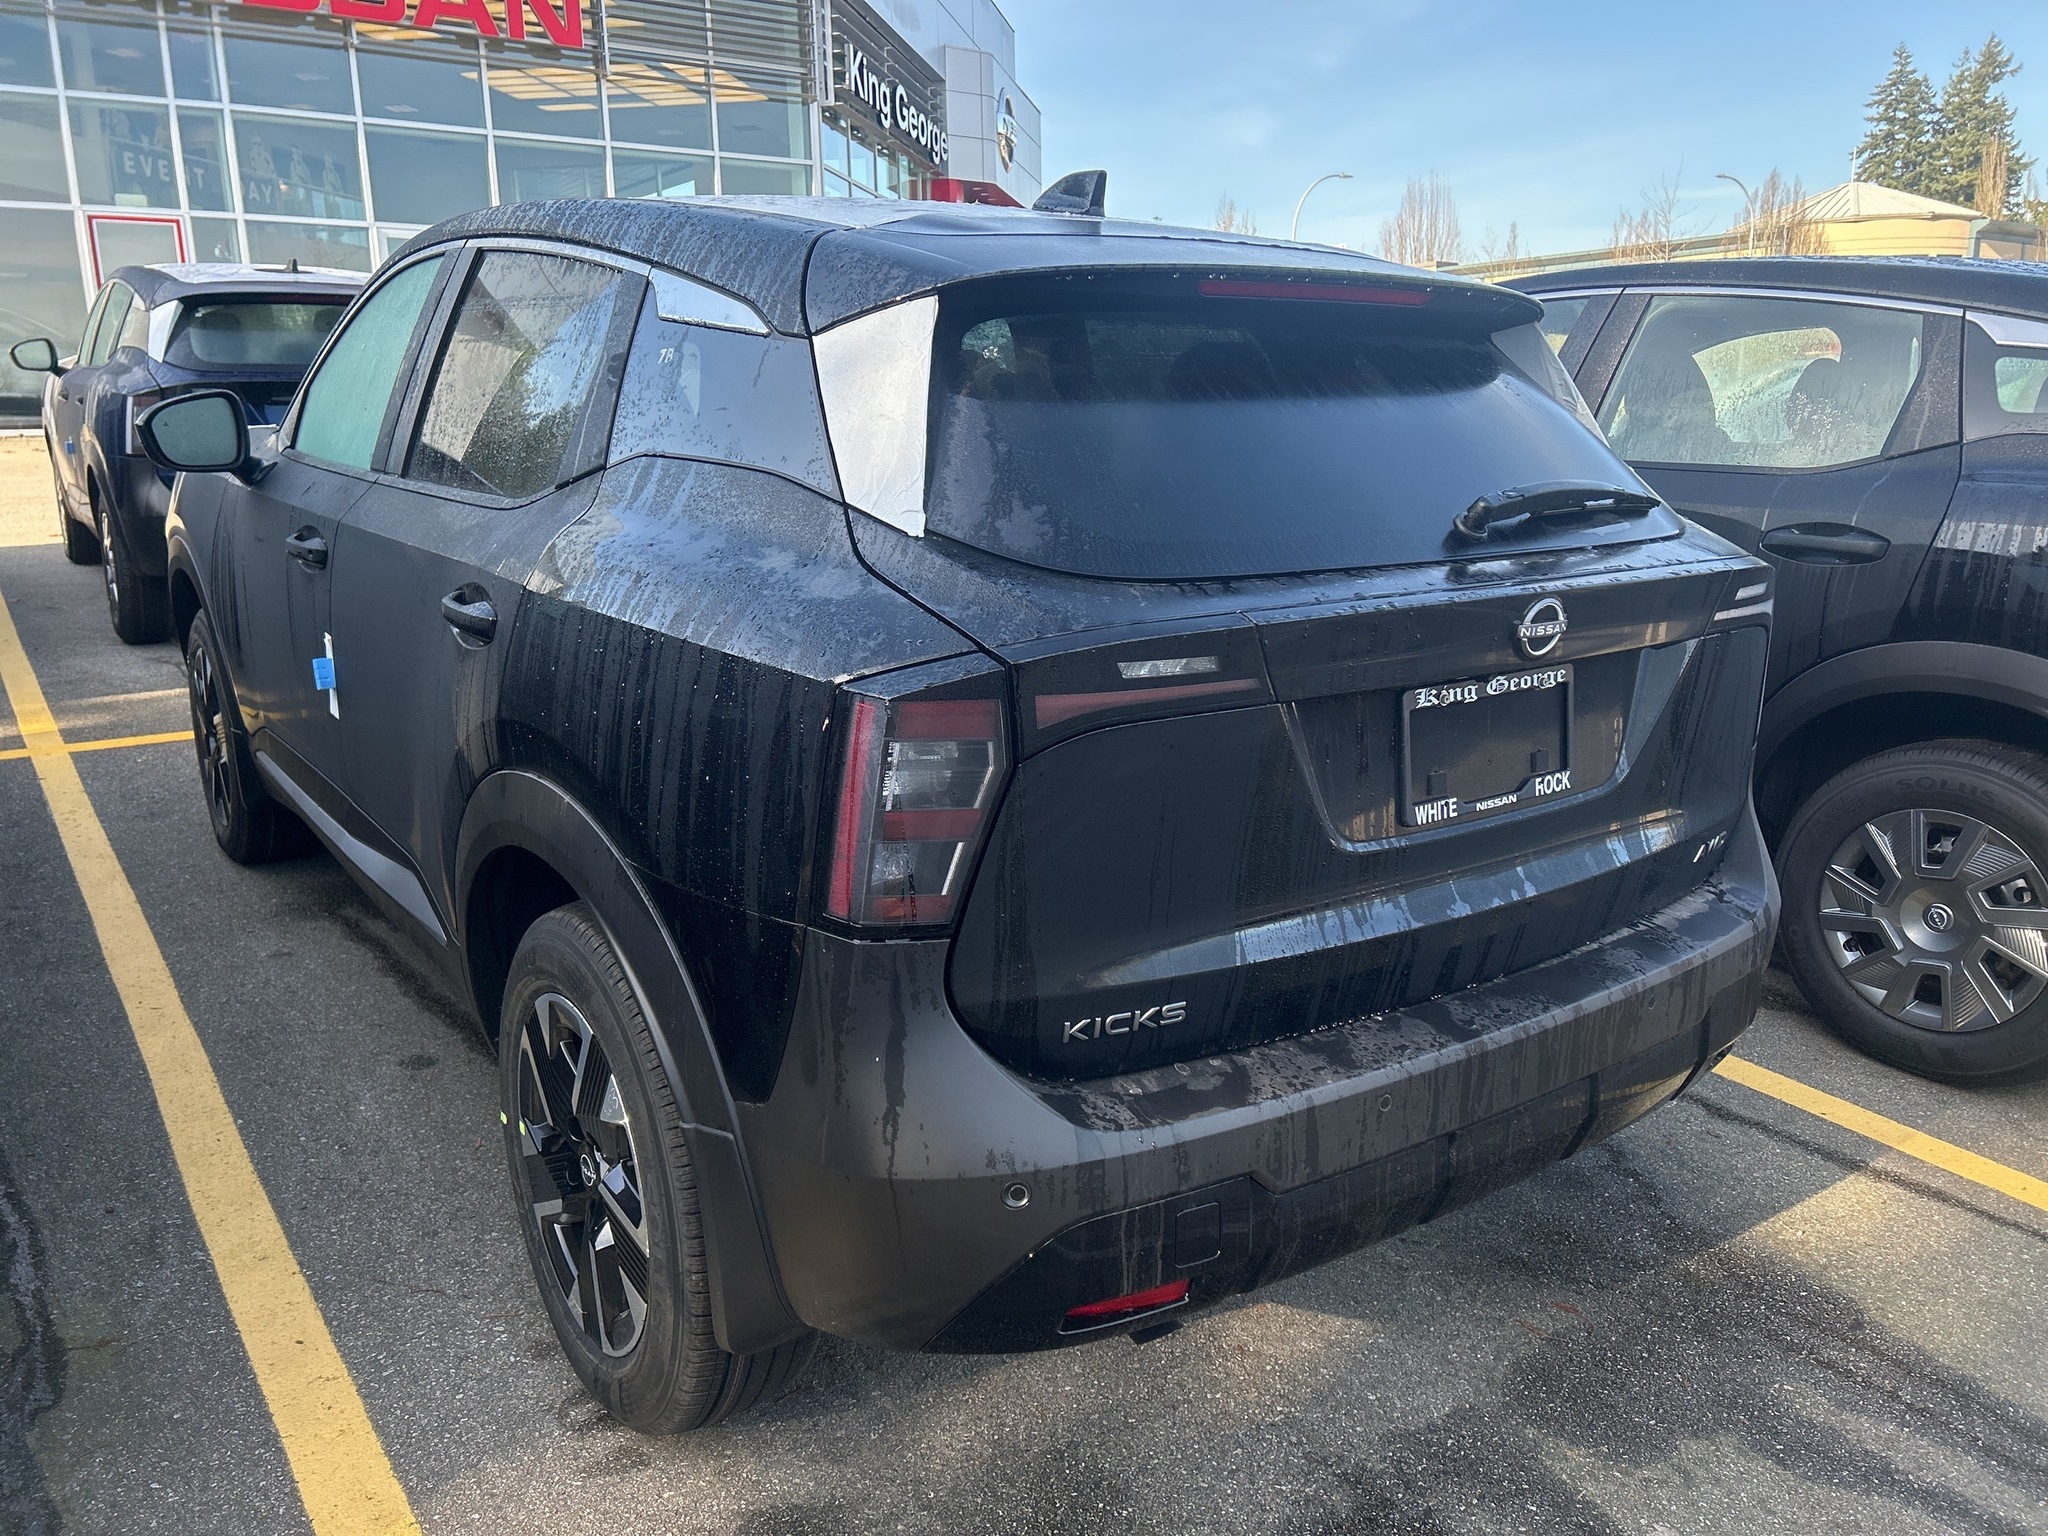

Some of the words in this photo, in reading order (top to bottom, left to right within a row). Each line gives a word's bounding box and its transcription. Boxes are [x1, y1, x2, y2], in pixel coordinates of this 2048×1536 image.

[848, 43, 891, 129] King
[895, 84, 949, 165] George
[1520, 620, 1567, 637] NISSAN
[1414, 684, 1479, 709] King
[1486, 668, 1567, 696] George
[1414, 797, 1458, 826] WHITE
[1476, 794, 1517, 811] NISSAN
[1534, 770, 1572, 797] ROCK
[1062, 1000, 1187, 1044] KICKS
